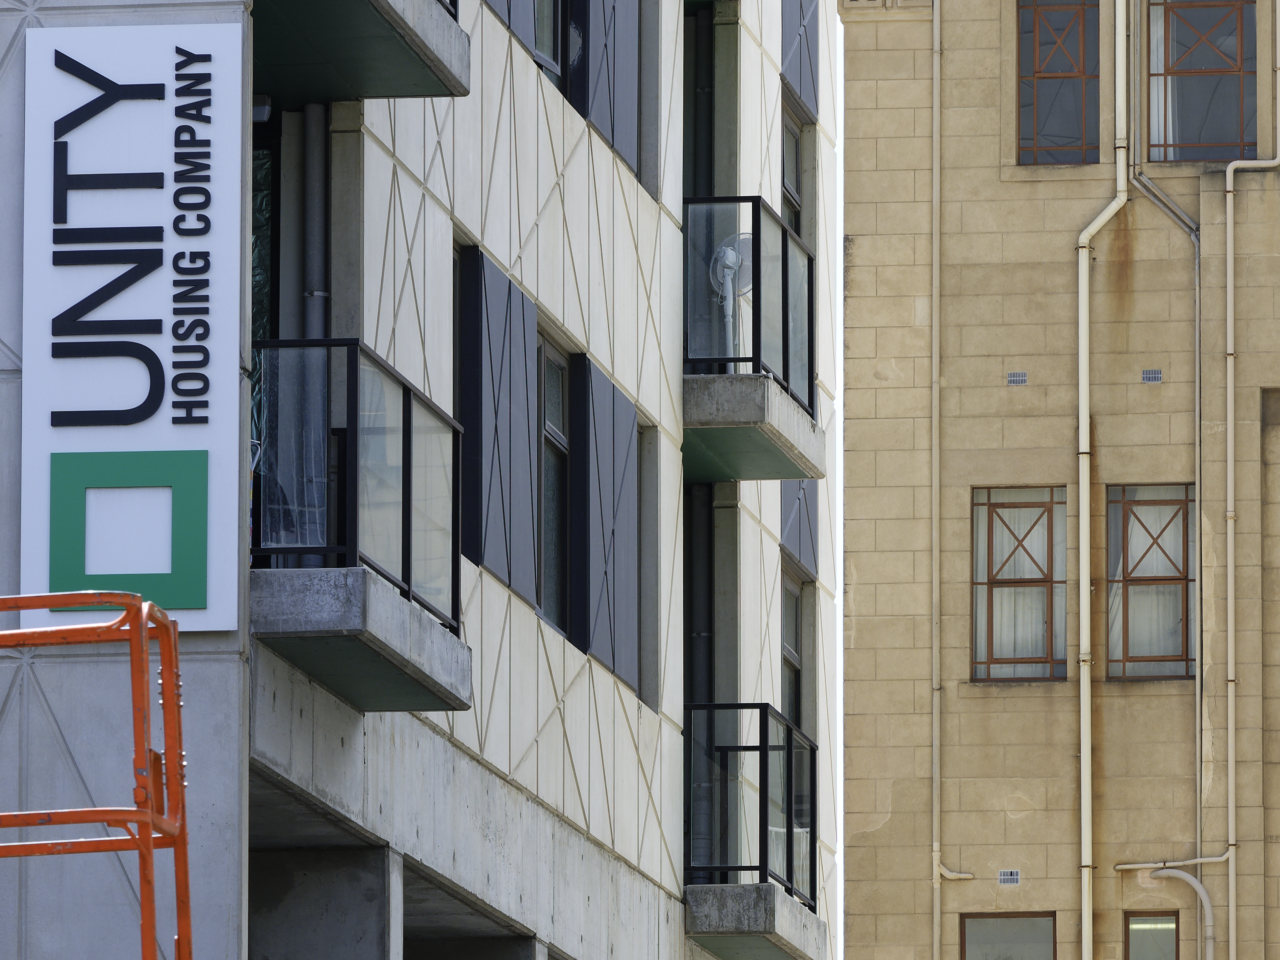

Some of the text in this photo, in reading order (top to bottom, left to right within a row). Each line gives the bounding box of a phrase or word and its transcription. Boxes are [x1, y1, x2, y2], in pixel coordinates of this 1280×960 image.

[51, 49, 166, 427] UNITY
[171, 46, 213, 425] HOUSING COMPANY
